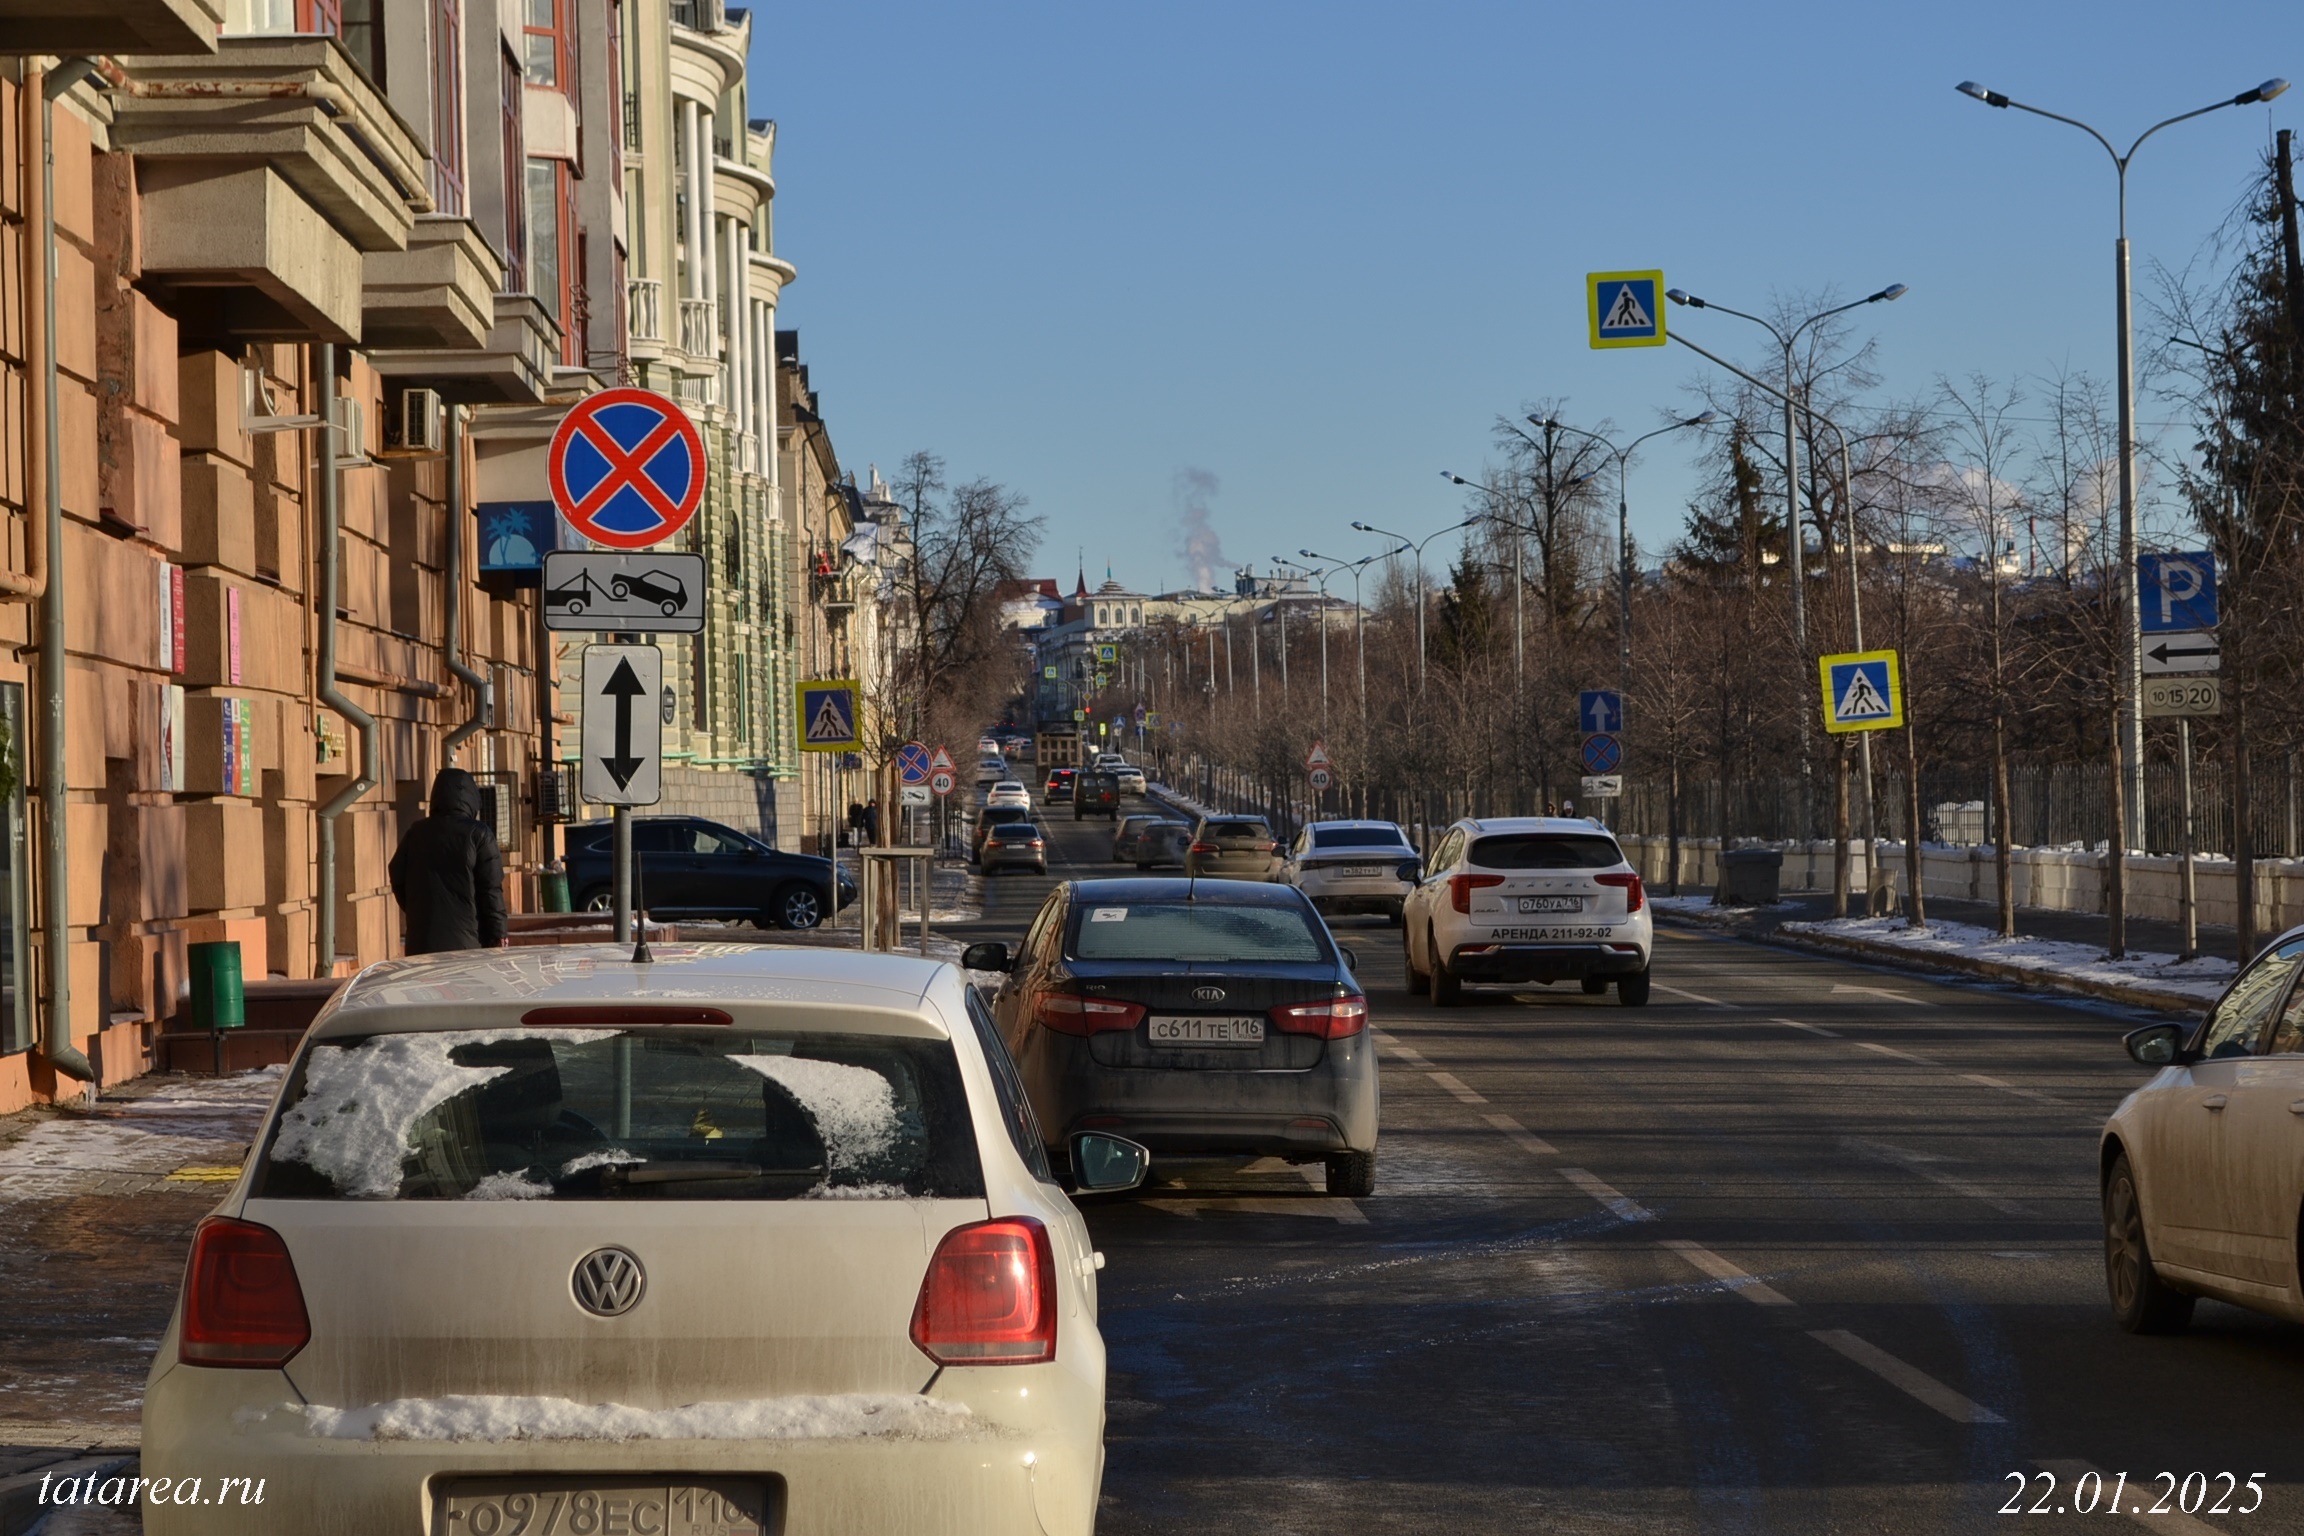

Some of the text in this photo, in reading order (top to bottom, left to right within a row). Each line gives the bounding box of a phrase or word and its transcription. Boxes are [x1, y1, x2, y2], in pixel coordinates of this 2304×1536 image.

[2159, 561, 2203, 623] P
[2152, 687, 2212, 705] 10 15 20
[935, 777, 949, 788] 40
[1312, 773, 1327, 784] 40
[1491, 927, 1612, 940] АРЕНДА 211-92-02
[1197, 990, 1220, 1000] KIA
[1232, 1019, 1259, 1034] 116
